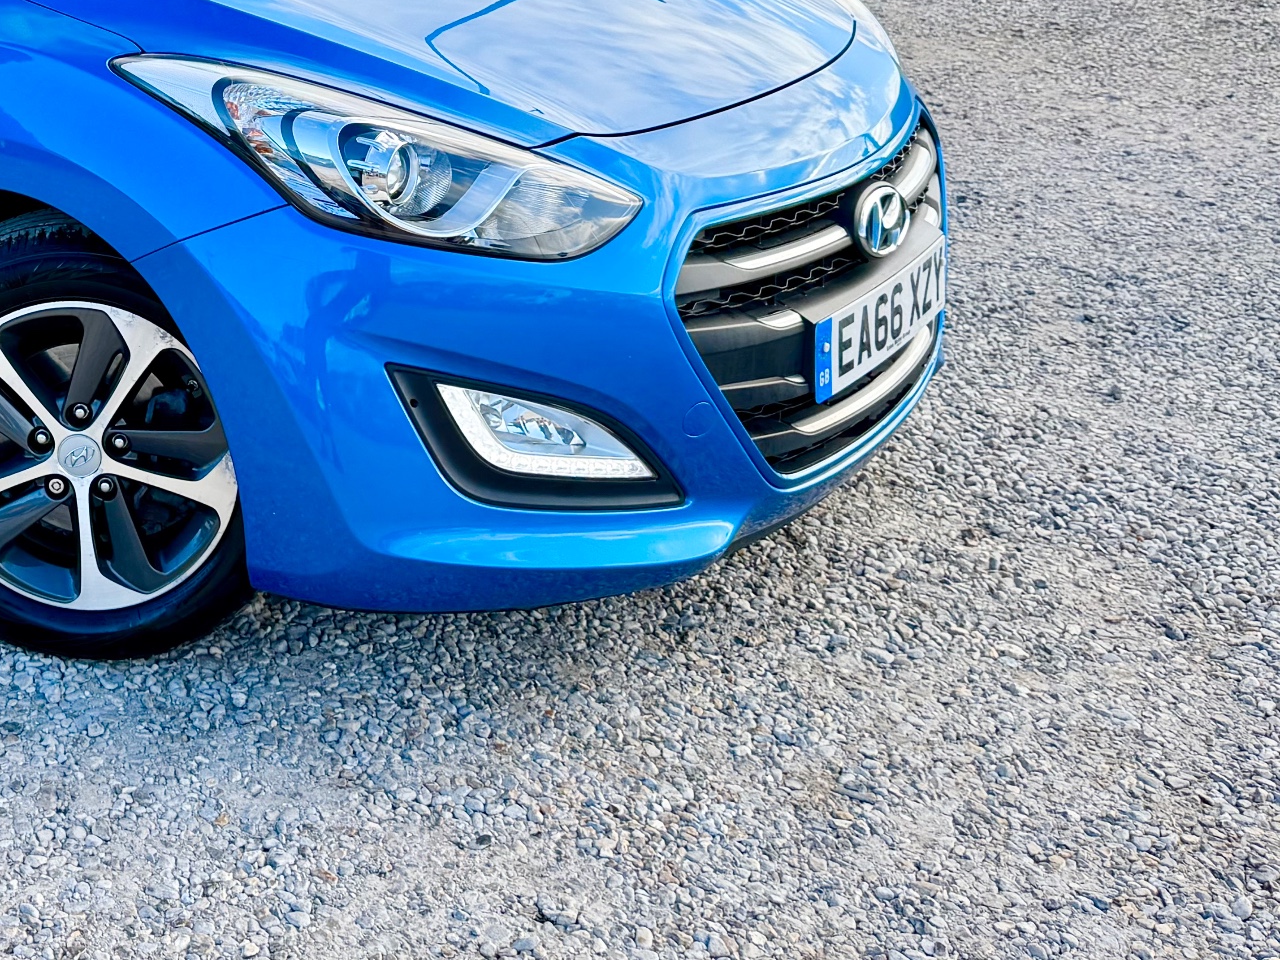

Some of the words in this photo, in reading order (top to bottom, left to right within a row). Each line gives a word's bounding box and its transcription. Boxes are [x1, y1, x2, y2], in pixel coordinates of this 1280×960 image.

[838, 282, 903, 378] EA66
[909, 246, 943, 327] XZY
[819, 368, 830, 387] GB
